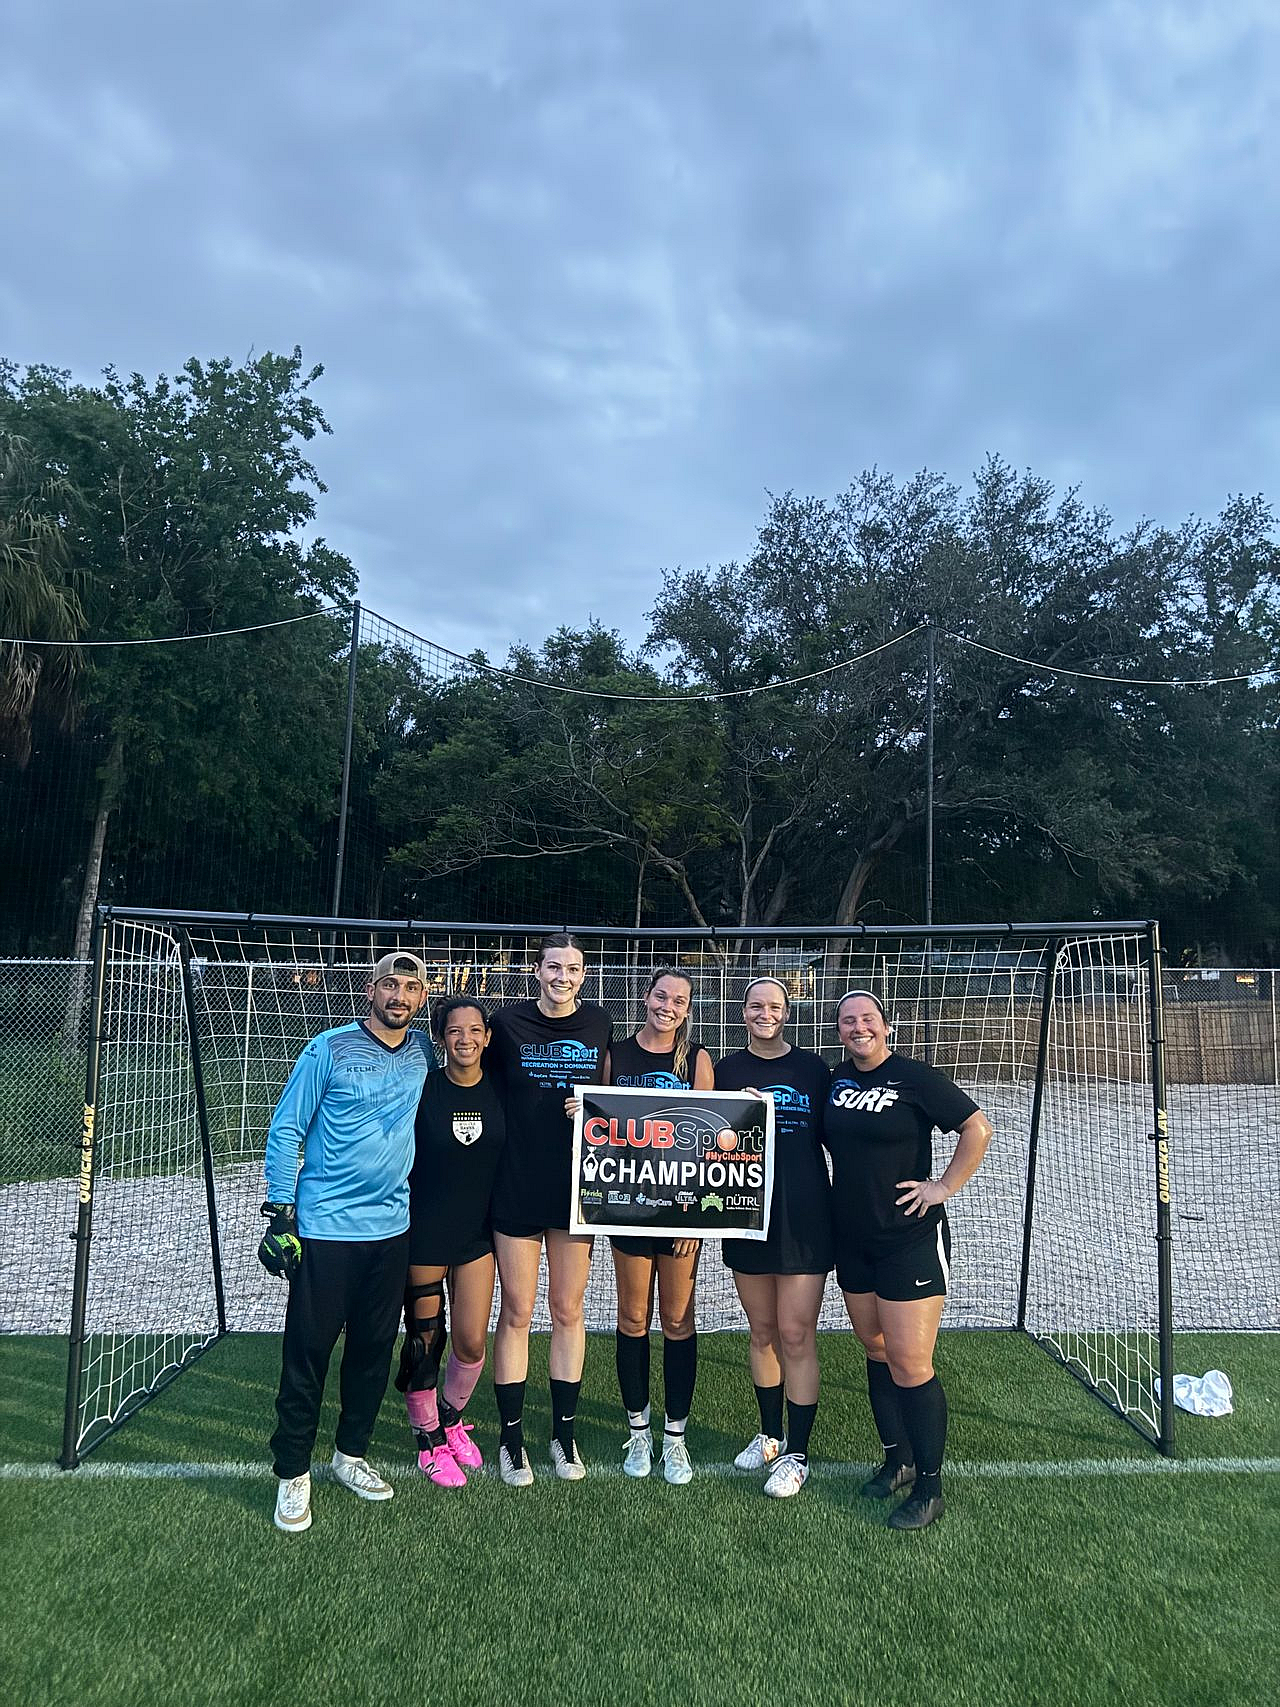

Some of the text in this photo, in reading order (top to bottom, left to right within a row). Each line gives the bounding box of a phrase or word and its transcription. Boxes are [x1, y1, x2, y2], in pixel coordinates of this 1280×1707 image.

[521, 1061, 559, 1069] RECREATION
[832, 1088, 900, 1113] SURF
[583, 1116, 764, 1157] CLUBSport
[79, 1103, 95, 1204] QUICKPLAY
[705, 1151, 763, 1163] #MyClubSport
[1157, 1108, 1170, 1205] QUICKPLAY
[598, 1157, 764, 1188] CHAMPIONS
